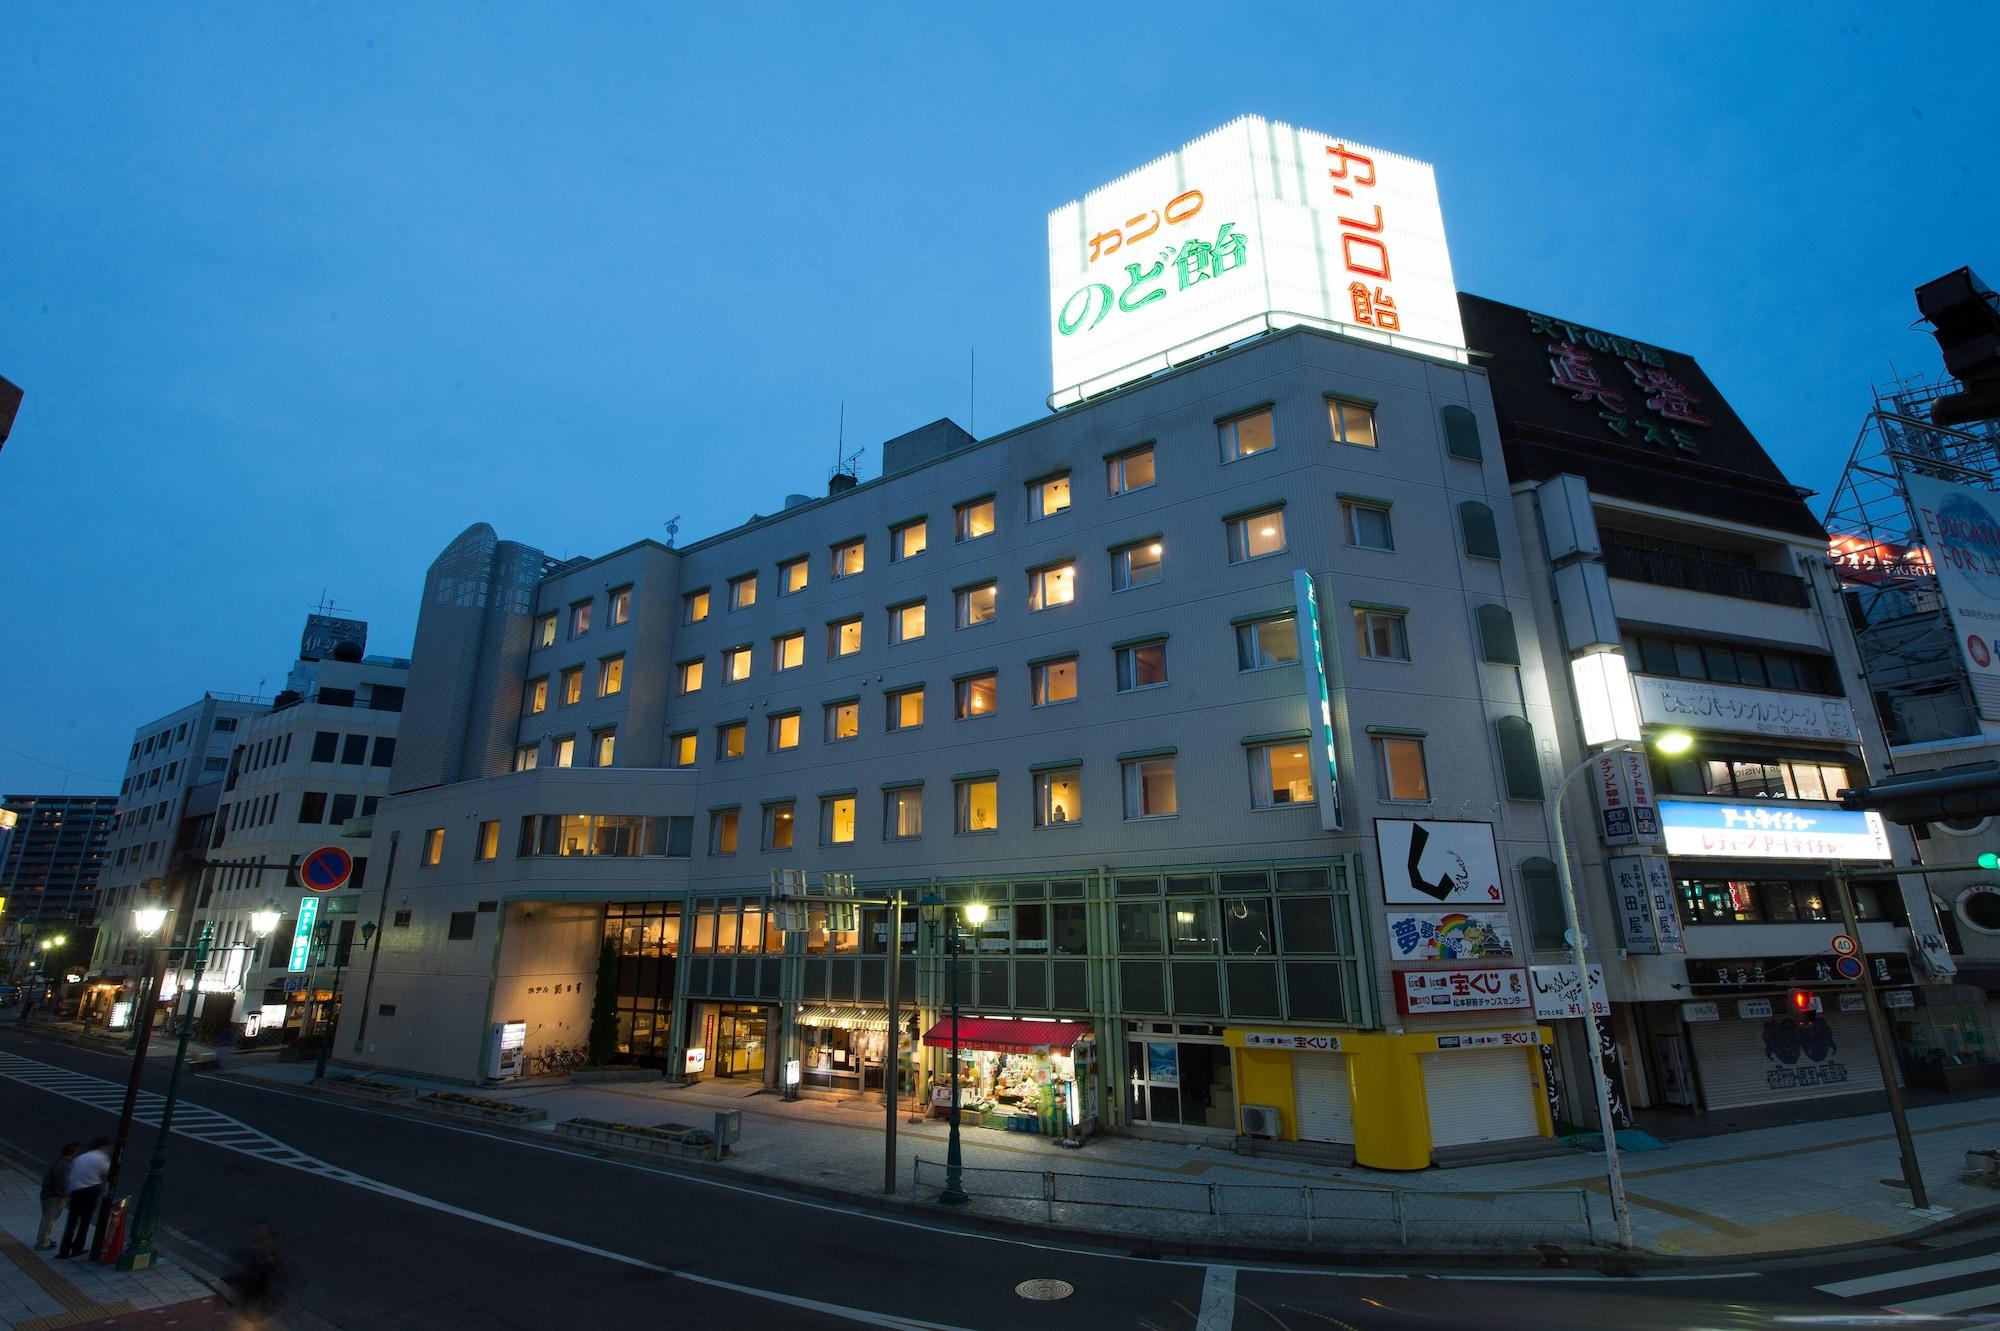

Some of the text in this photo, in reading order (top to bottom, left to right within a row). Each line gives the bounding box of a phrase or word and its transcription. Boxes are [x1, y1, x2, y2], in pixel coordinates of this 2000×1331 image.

[1089, 189, 1204, 263] カンロ
[1326, 143, 1400, 332] カンロ飴
[1058, 222, 1248, 337] のど飴
[1828, 549, 1876, 571] ラオケ
[1938, 542, 1978, 572] FOR
[1721, 808, 1817, 831] アートネイチャー
[1619, 872, 1643, 933] 松田屋
[1649, 871, 1671, 933] 松田屋
[1837, 940, 1850, 951] 40
[528, 985, 549, 994] ホテル
[1450, 973, 1501, 995] 宝くじ
[1294, 1036, 1328, 1049] 宝くじ
[1502, 1032, 1528, 1045] 宝くじ
